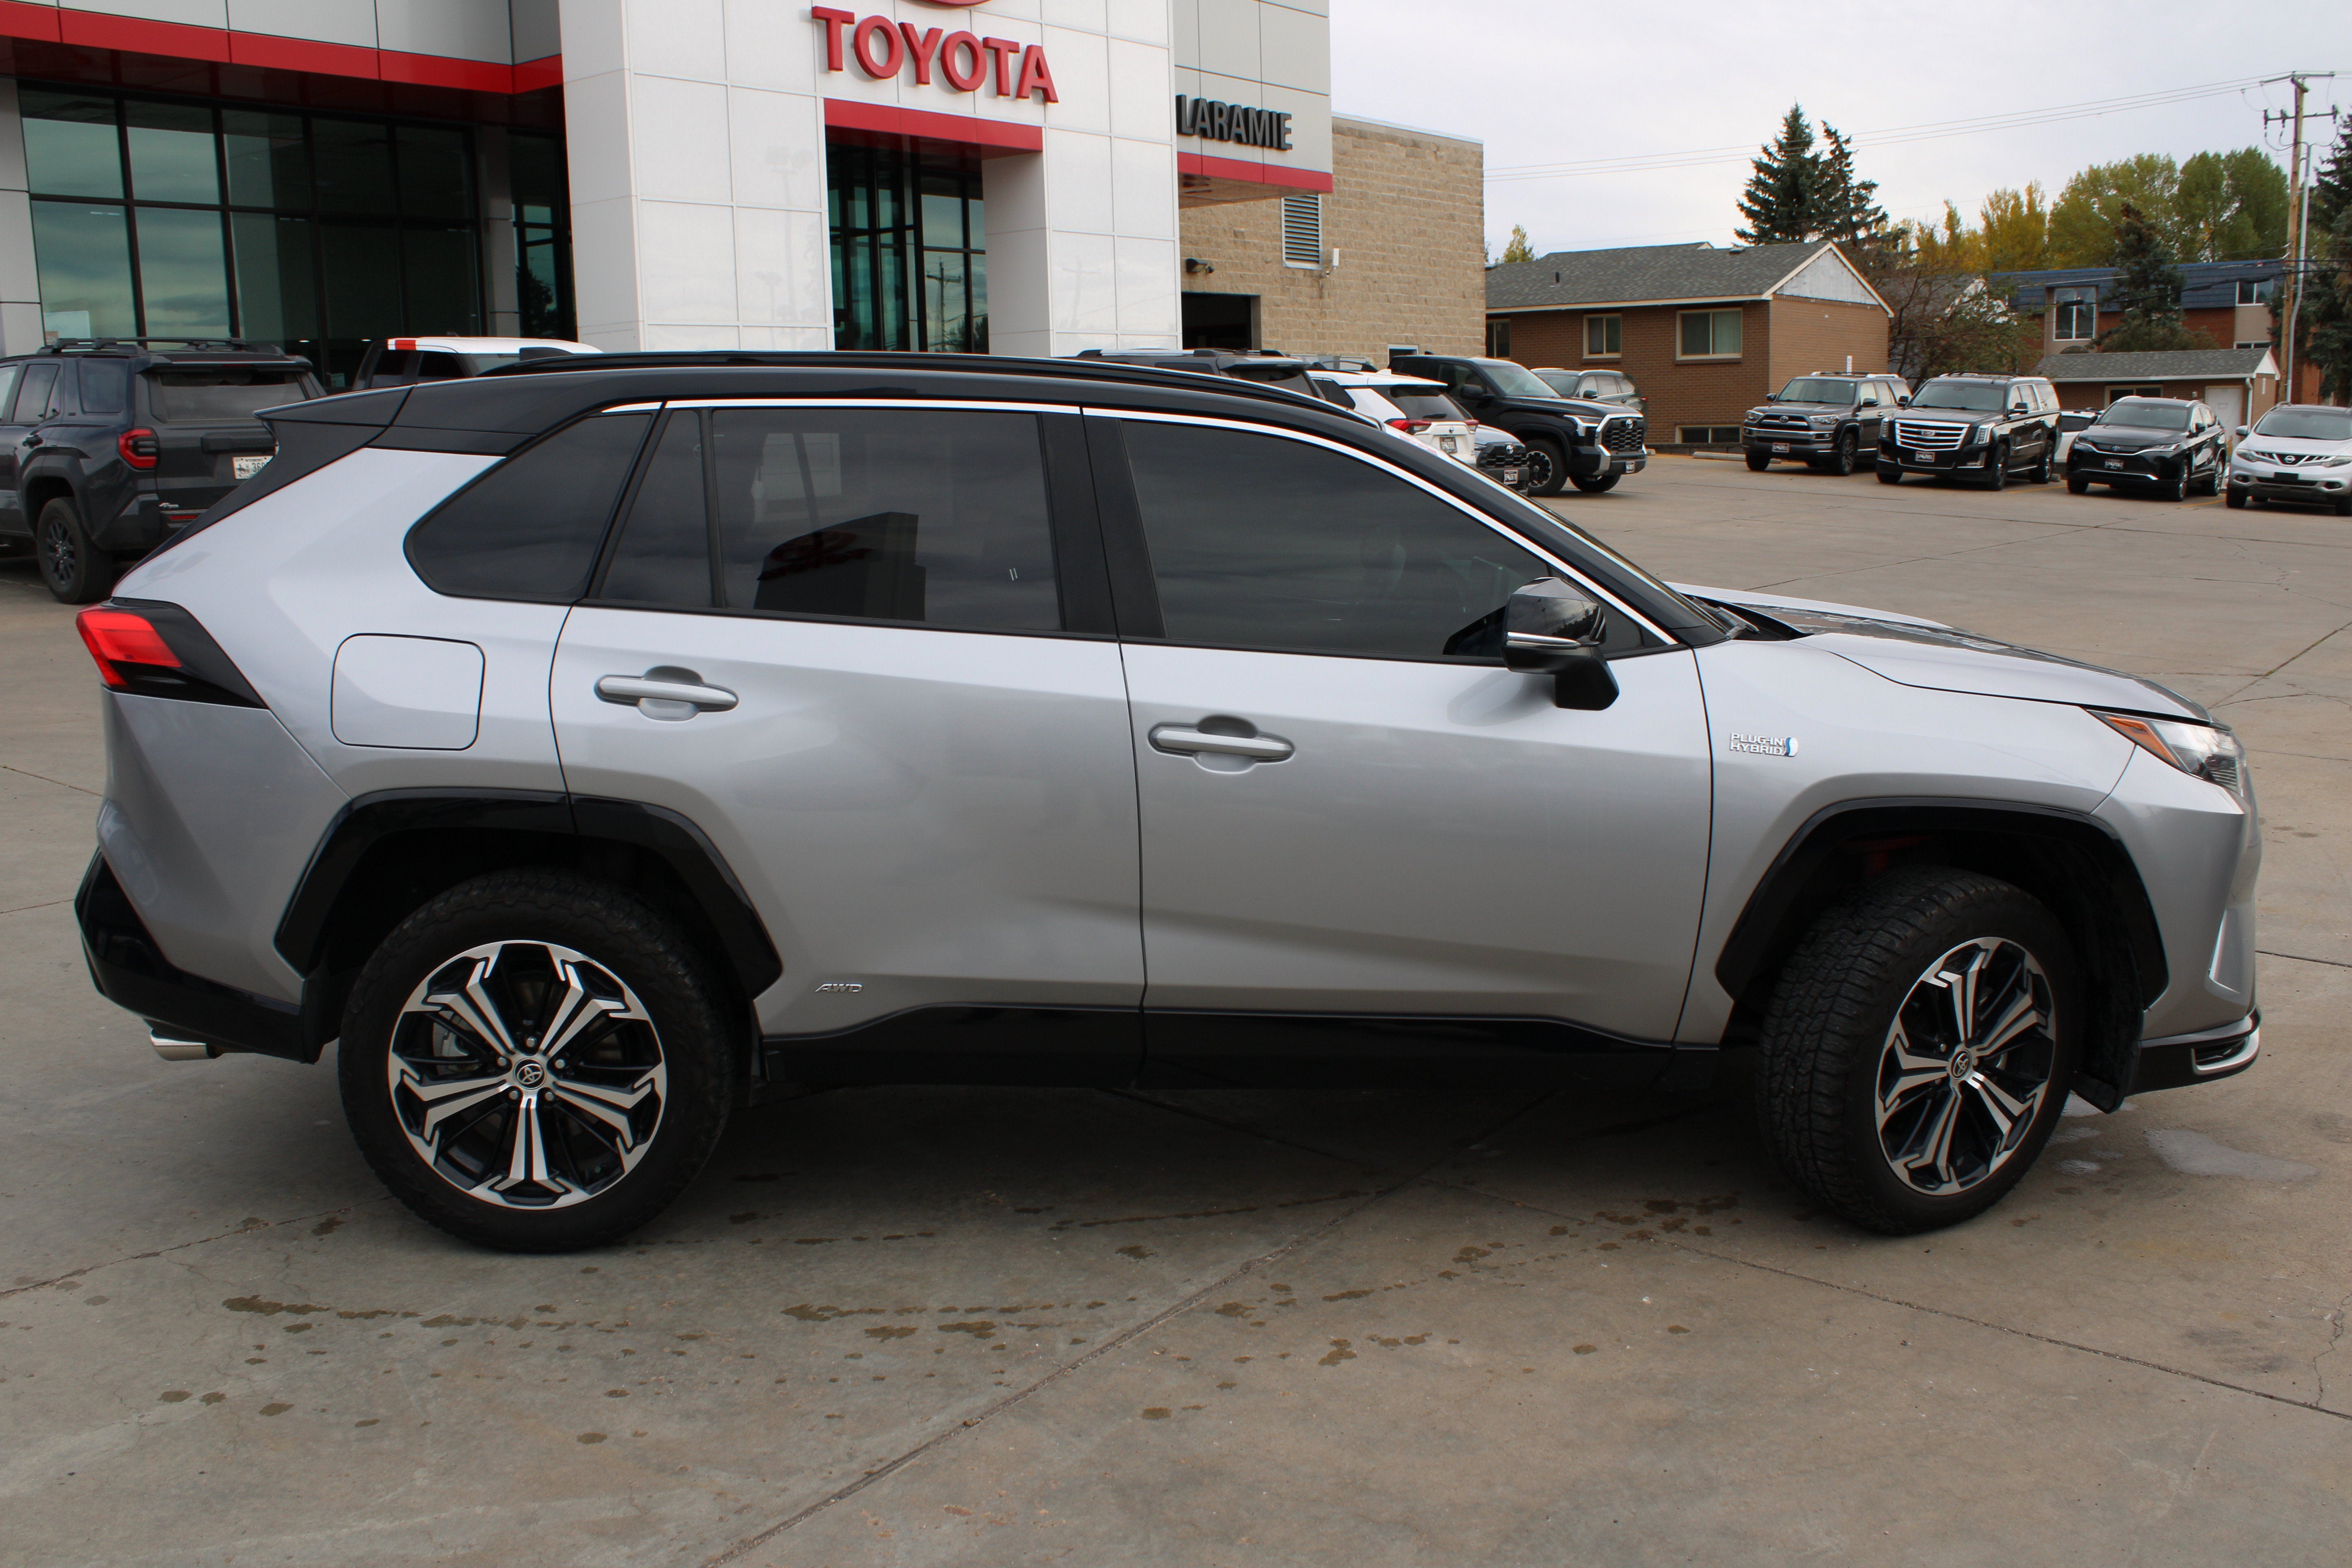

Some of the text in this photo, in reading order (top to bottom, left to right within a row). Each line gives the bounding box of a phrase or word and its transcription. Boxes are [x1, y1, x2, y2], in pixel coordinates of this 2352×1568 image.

[812, 6, 1059, 103] TOYOTA
[1176, 94, 1292, 150] LARAMIE
[1730, 733, 1784, 746] PLUG-IN
[1729, 741, 1783, 756] HYBRID
[815, 983, 863, 993] AWD
